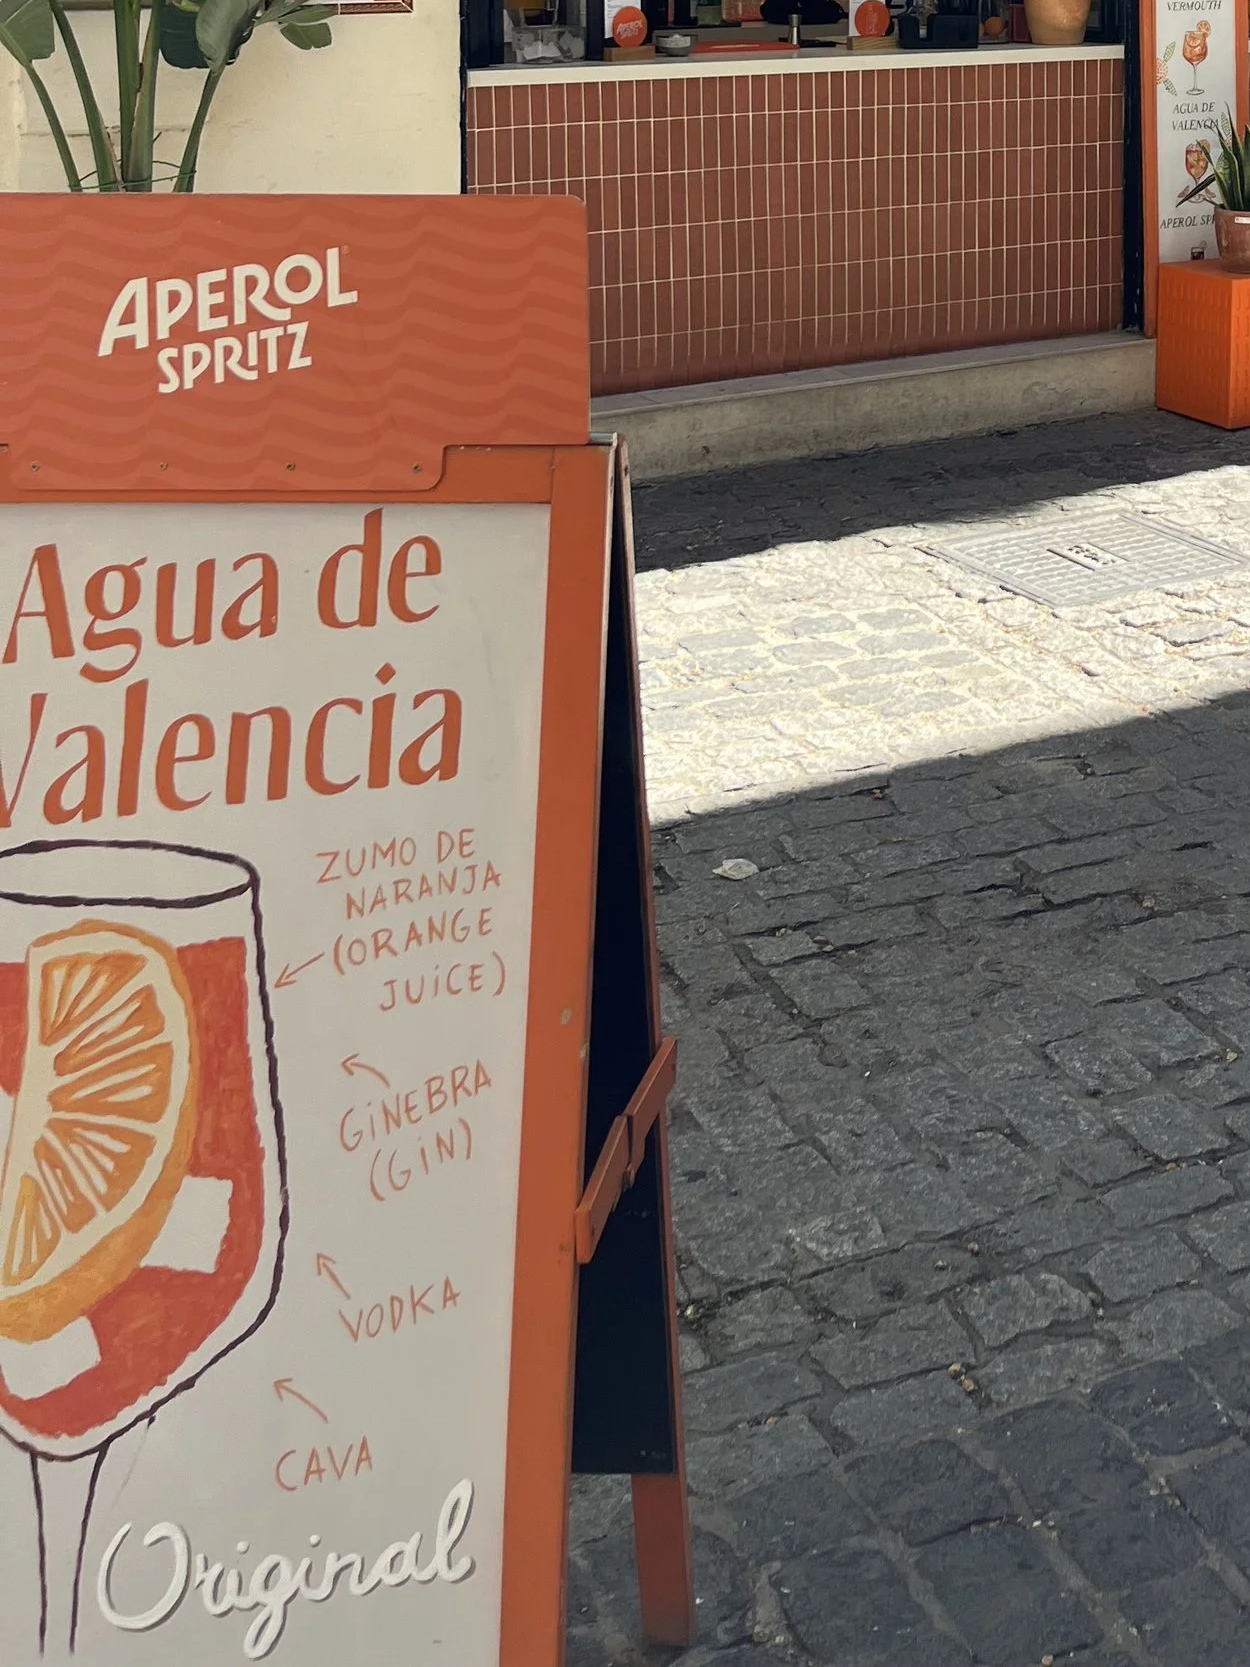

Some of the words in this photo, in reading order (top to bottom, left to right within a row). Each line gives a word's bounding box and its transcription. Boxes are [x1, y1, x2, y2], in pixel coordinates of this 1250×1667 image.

[1167, 0, 1222, 12] VERMOUTH
[1172, 102, 1199, 114] AGUA
[1201, 102, 1216, 112] DE
[1160, 216, 1197, 229] APEROL
[98, 246, 359, 358] APEROL
[158, 321, 313, 394] SPRITZ
[1, 543, 280, 683] Agua
[317, 507, 443, 628] de
[316, 836, 417, 884] ZUMO
[437, 828, 477, 864] DE
[344, 859, 502, 921] NARANJA
[332, 907, 494, 977] (ORANGE
[338, 1275, 461, 1343] VODKA
[274, 1435, 374, 1491] CAVA
[98, 1477, 476, 1660] Original
